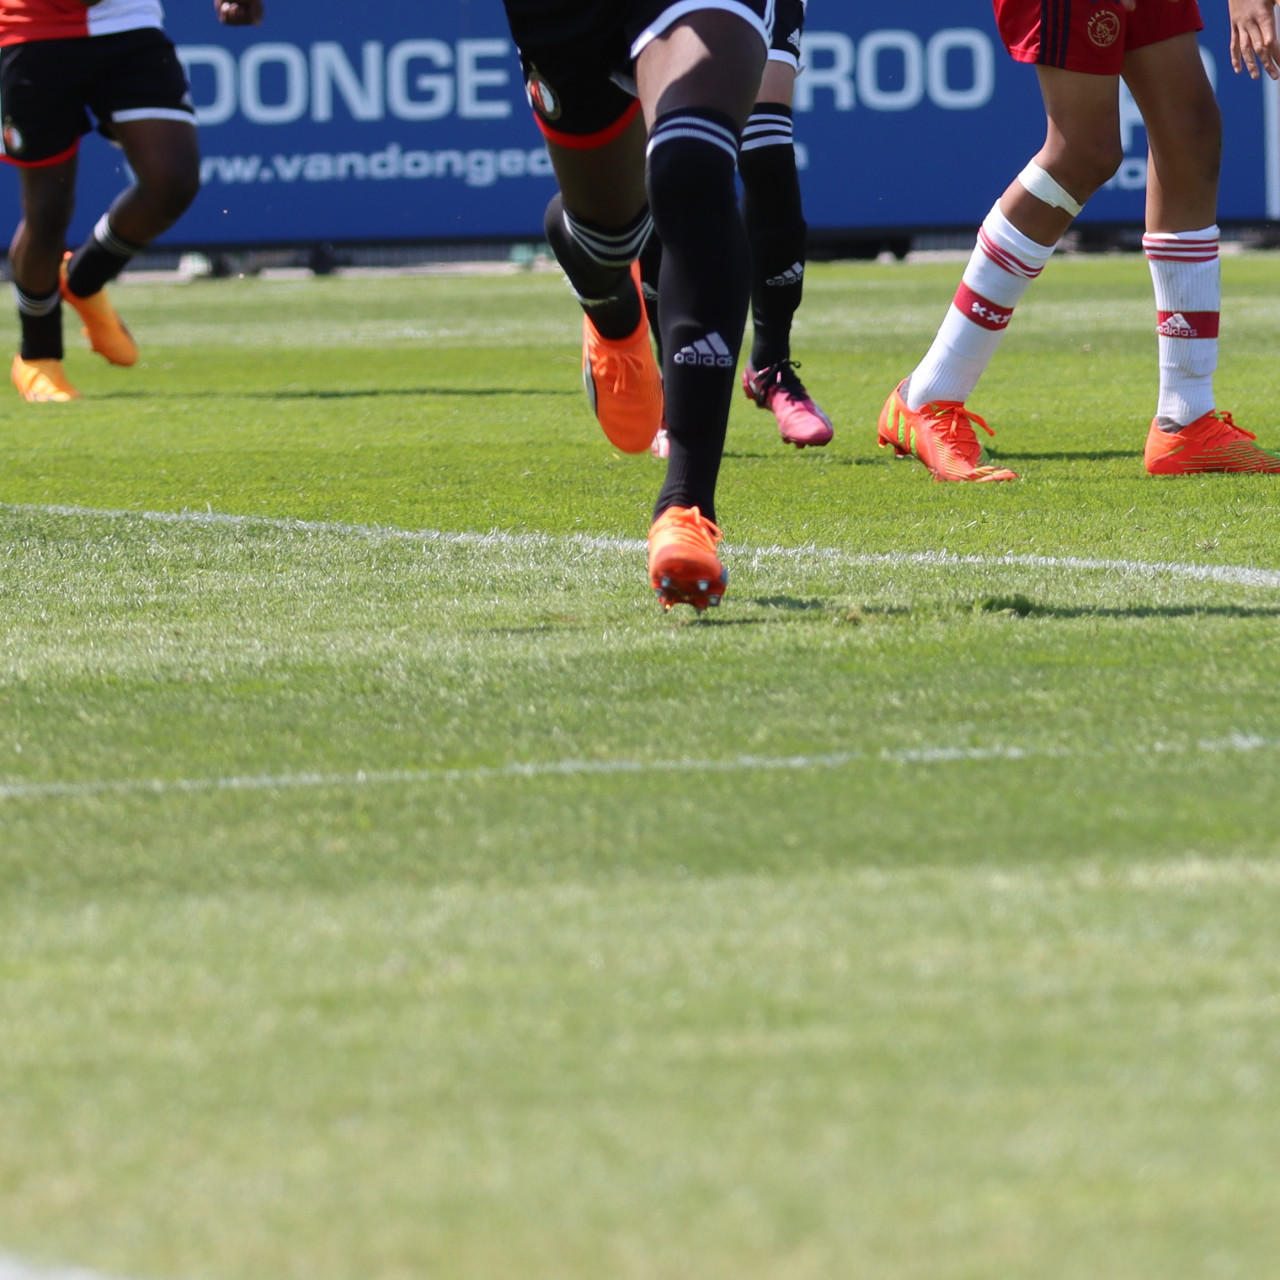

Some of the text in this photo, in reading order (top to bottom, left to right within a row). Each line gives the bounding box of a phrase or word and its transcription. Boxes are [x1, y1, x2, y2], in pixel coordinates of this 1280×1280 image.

[1087, 9, 1107, 28] AJAX
[793, 27, 995, 112] ROO
[176, 36, 512, 124] DONGE
[1156, 320, 1197, 337] adidas
[674, 350, 733, 368] adidas
